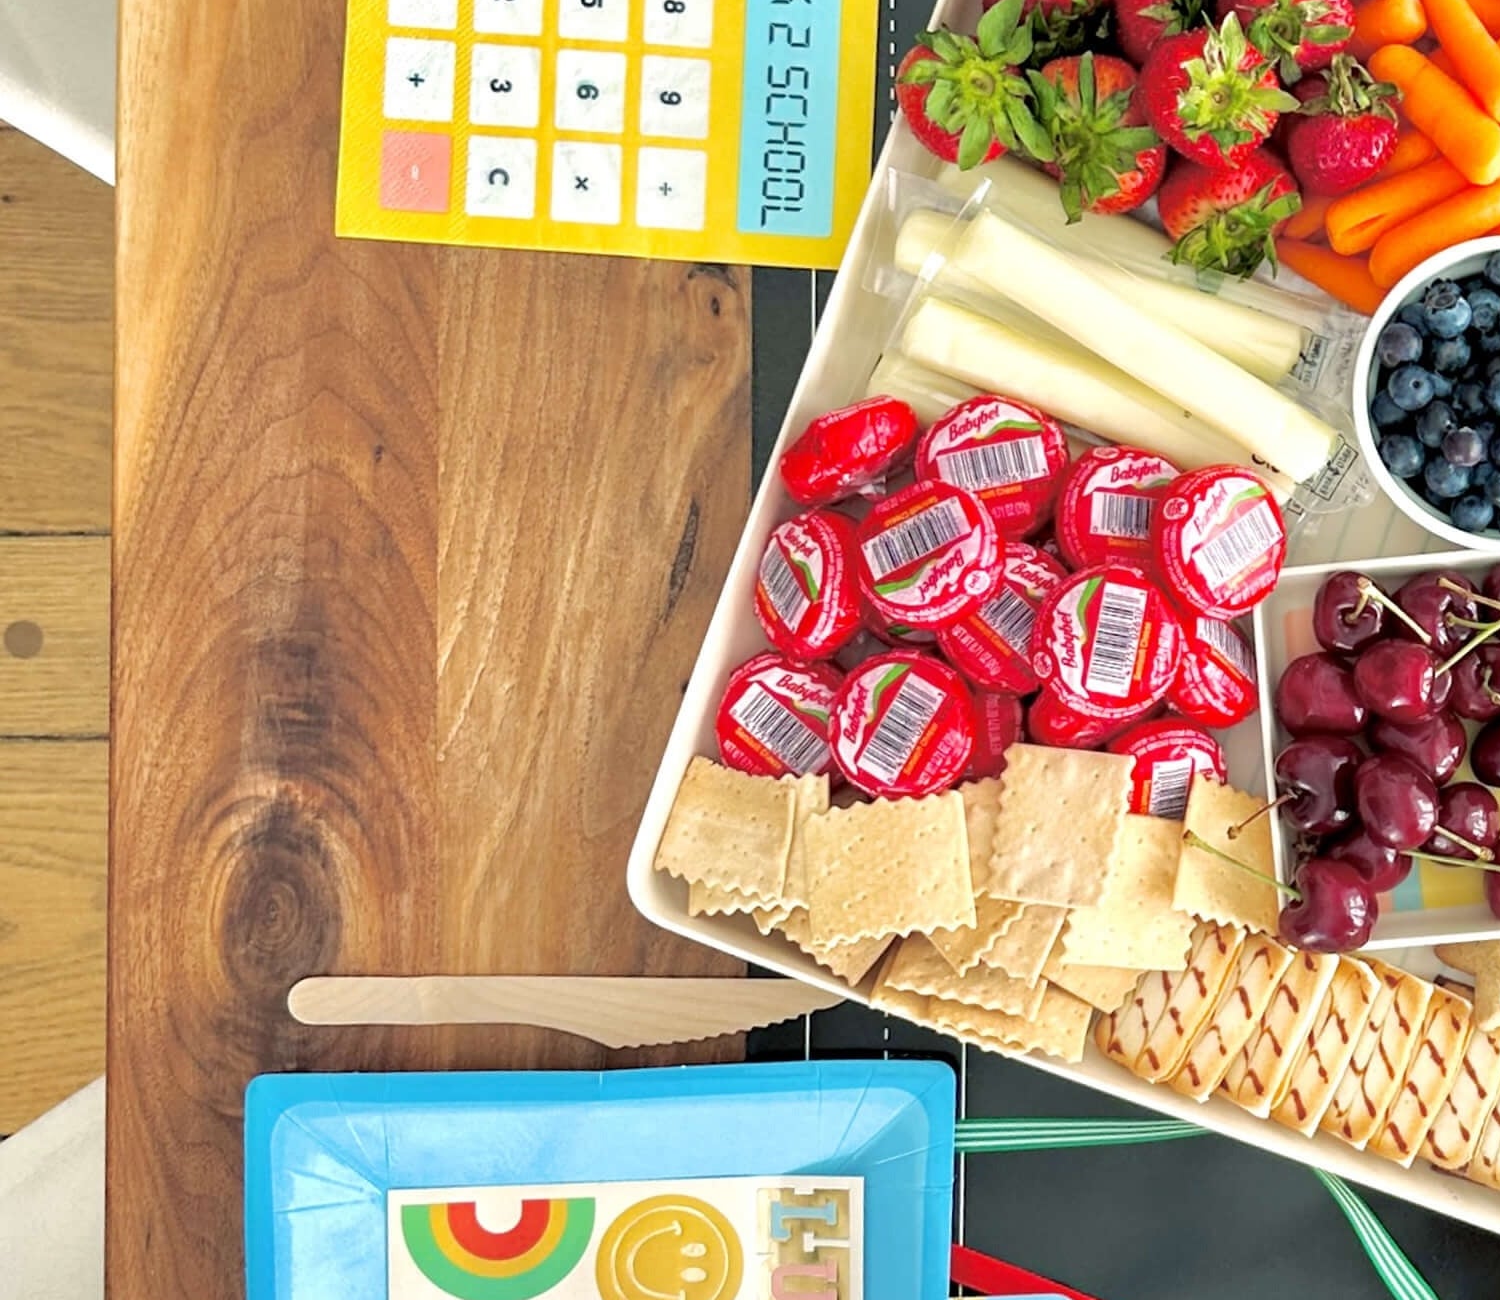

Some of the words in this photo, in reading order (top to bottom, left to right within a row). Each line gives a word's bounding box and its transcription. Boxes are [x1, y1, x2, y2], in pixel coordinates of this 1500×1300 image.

[663, 0, 686, 14] 8
[768, 23, 811, 49] 2
[489, 78, 512, 93] 3
[576, 83, 599, 101] 6
[659, 91, 682, 106] 9
[760, 65, 811, 228] SCHOOL
[488, 168, 510, 186] C
[948, 404, 1001, 442] Babybel
[1109, 460, 1163, 483] Babybel
[918, 548, 964, 601] Babybel
[1060, 610, 1079, 669] Babybel
[843, 683, 870, 744] Babybel
